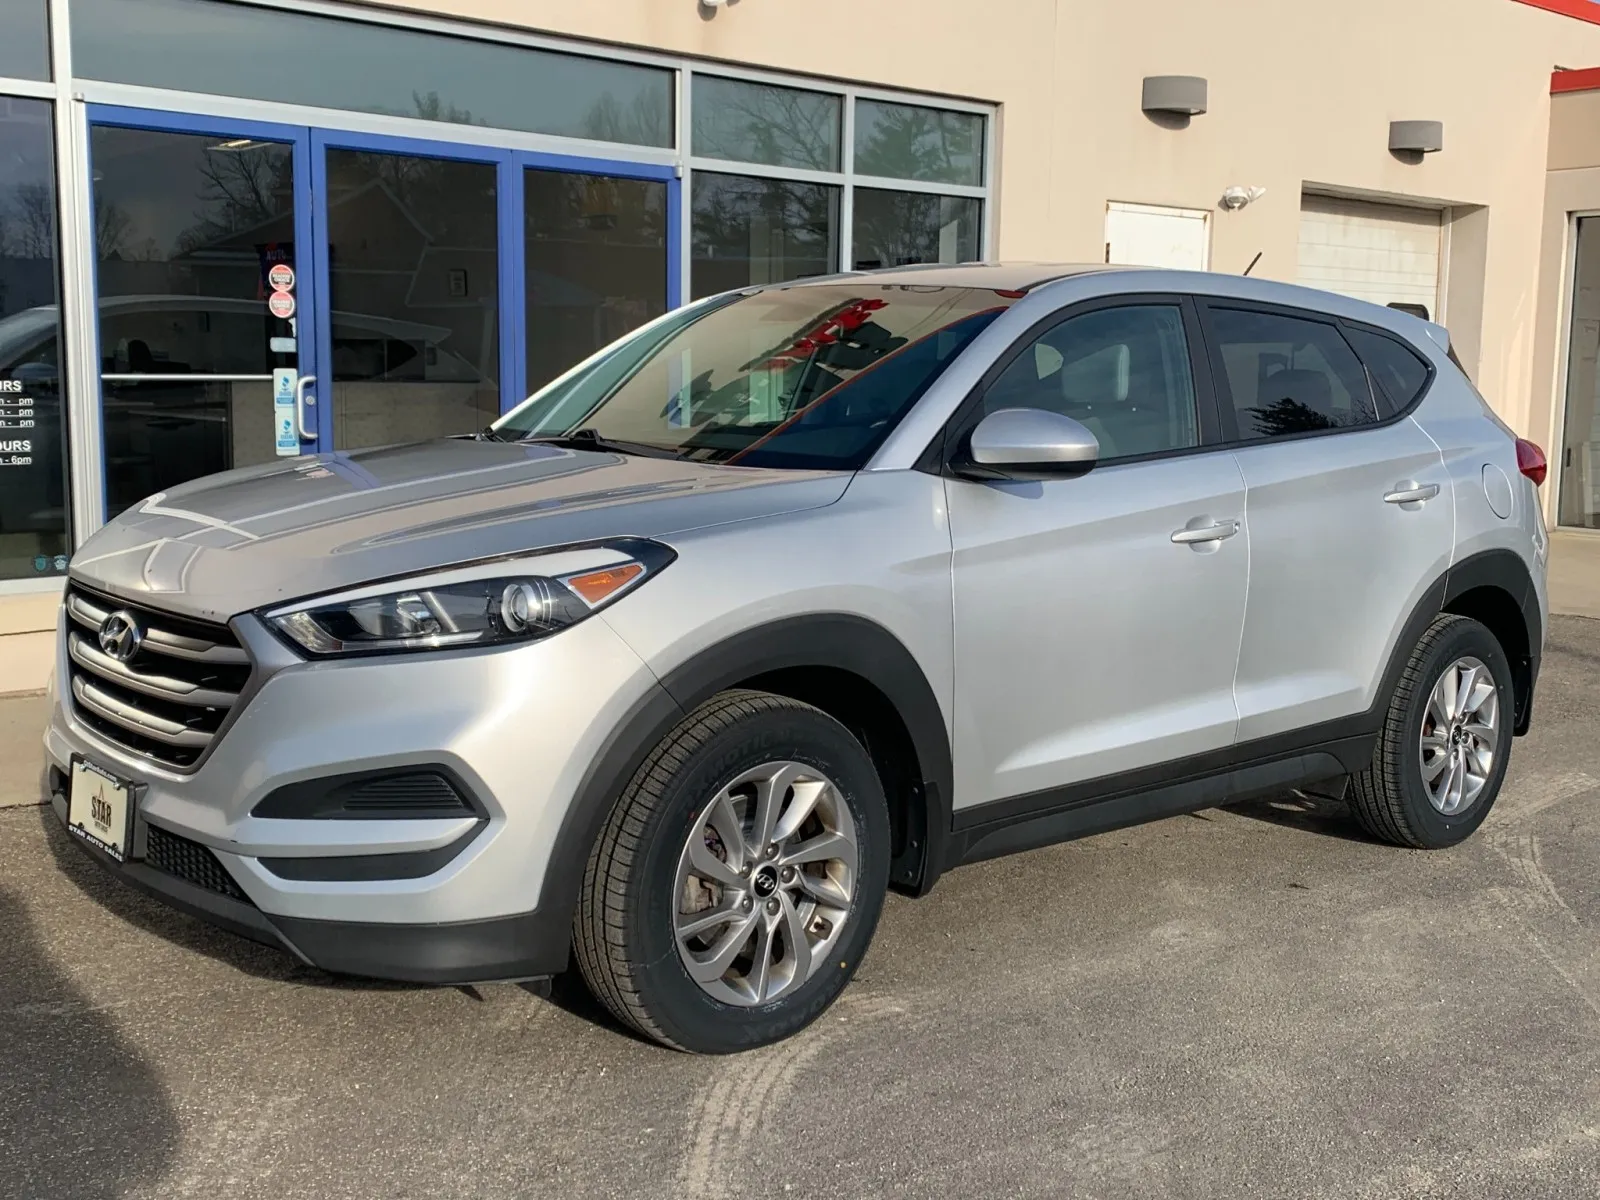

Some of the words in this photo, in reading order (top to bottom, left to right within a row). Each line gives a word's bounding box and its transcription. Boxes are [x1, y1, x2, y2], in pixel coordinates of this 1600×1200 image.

[0, 380, 22, 391] RS
[18, 398, 34, 407] pm
[18, 409, 34, 418] pm
[19, 419, 35, 429] pm
[0, 440, 31, 451] URS
[11, 455, 32, 465] 6pm
[91, 795, 112, 828] STAR
[68, 824, 86, 838] STAR
[86, 834, 104, 849] AUTO
[104, 844, 123, 862] SALES
